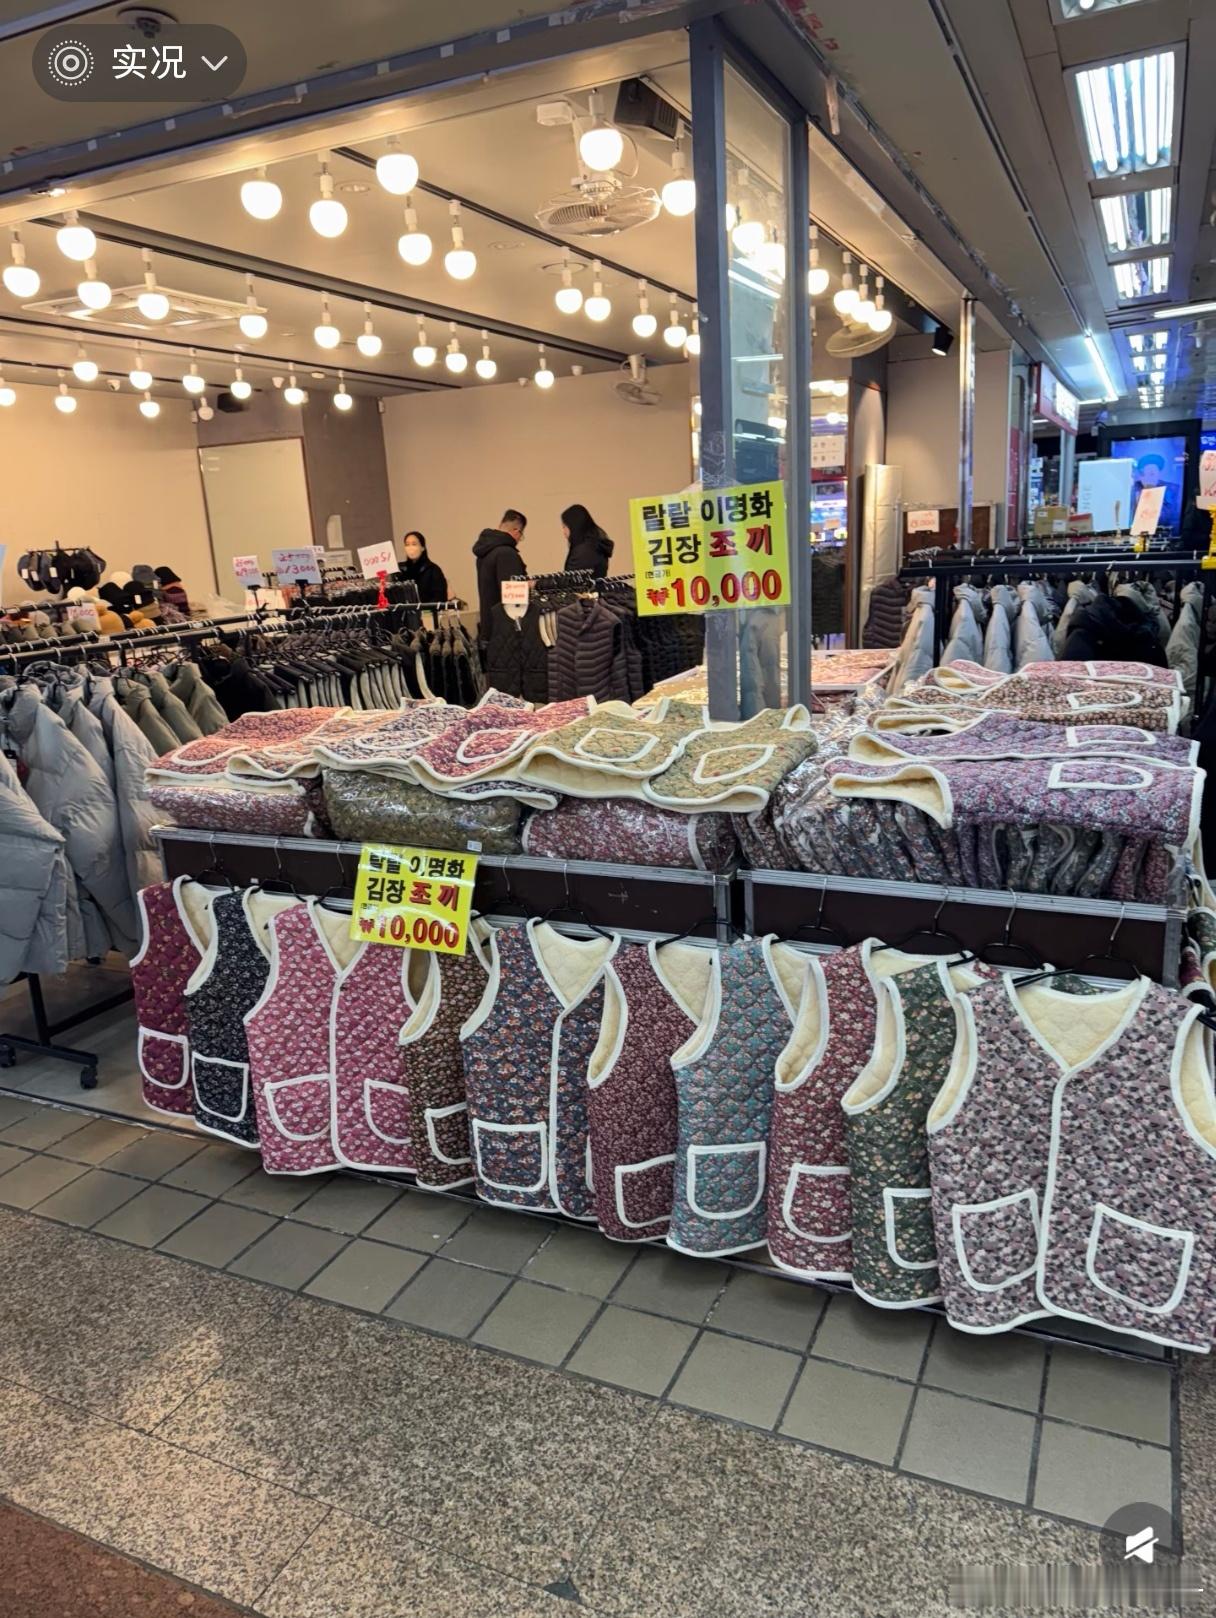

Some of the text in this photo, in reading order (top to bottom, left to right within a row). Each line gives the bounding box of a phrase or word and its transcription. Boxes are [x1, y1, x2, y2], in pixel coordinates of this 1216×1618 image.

[642, 490, 773, 532] 랄랄 이명화
[648, 534, 701, 566] 김장
[646, 569, 782, 608] ₩10,000
[367, 878, 406, 904] 김장
